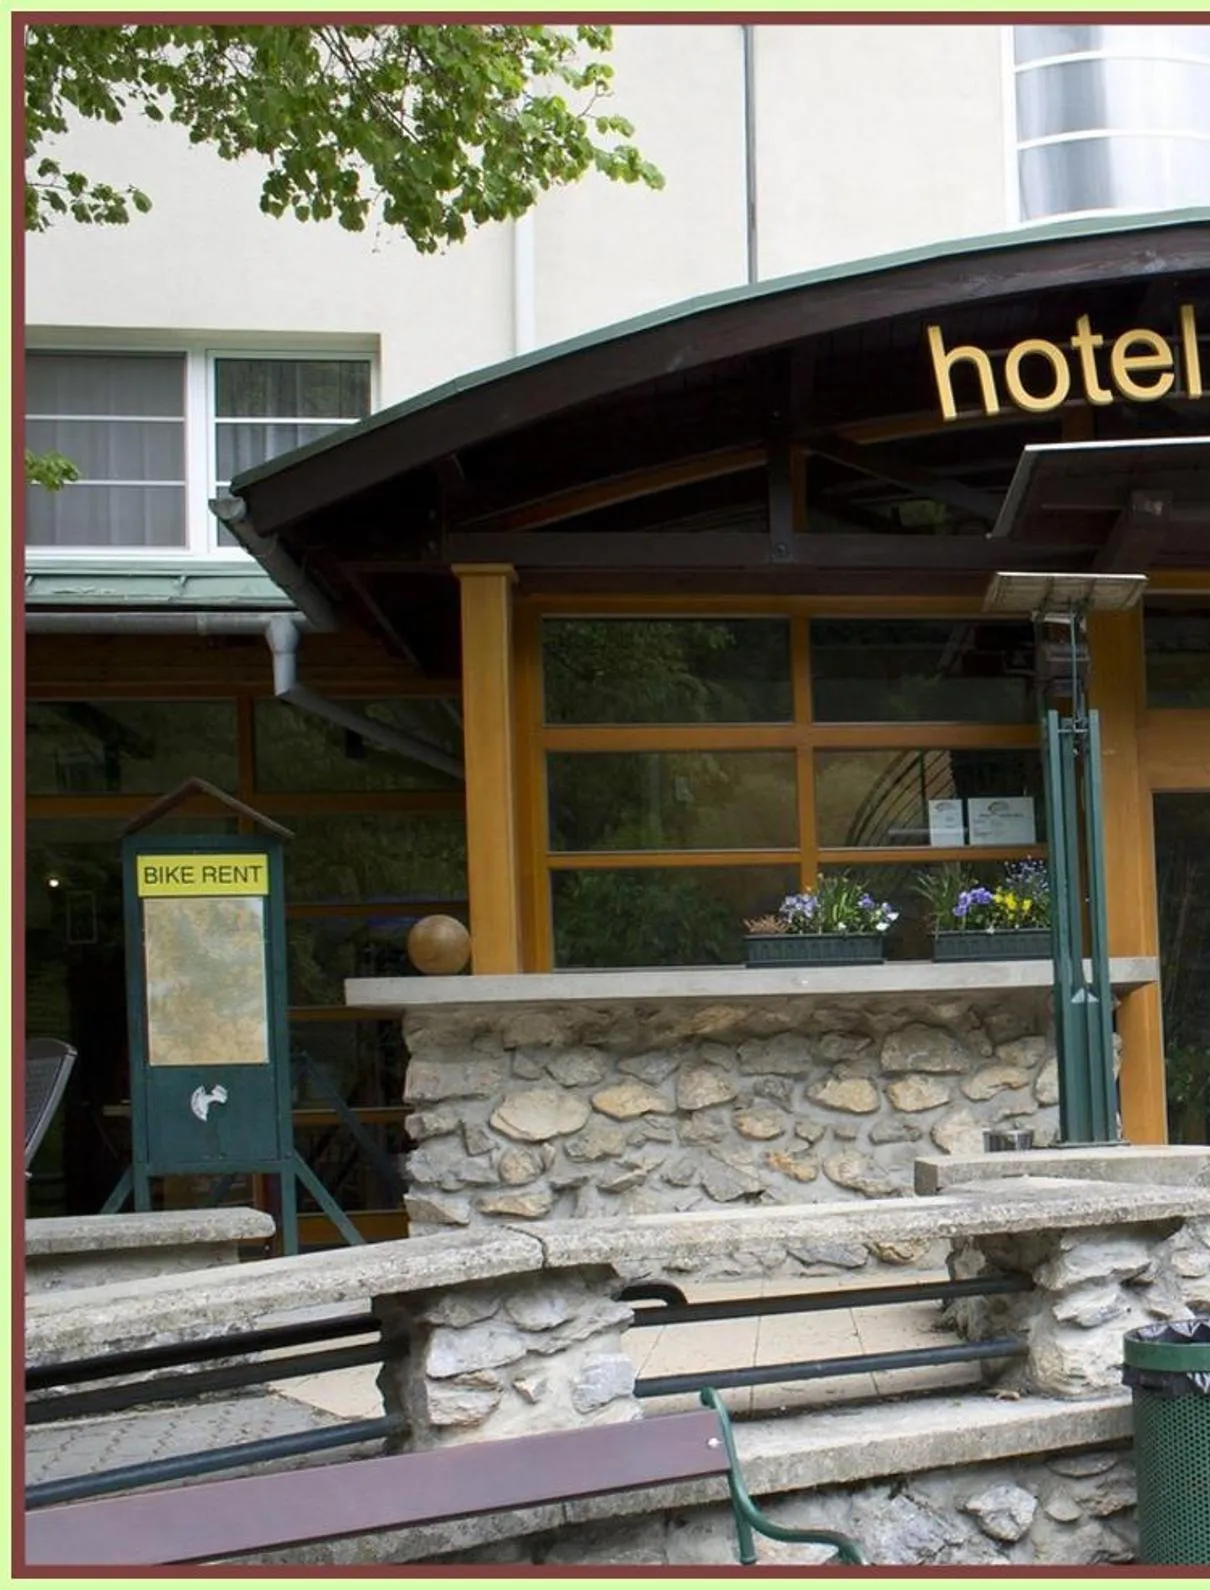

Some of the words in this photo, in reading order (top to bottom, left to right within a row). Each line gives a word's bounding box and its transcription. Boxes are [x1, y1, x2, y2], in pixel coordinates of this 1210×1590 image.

[926, 304, 1203, 420] hotel
[143, 866, 195, 884] BIKE
[202, 865, 263, 884] RENT
